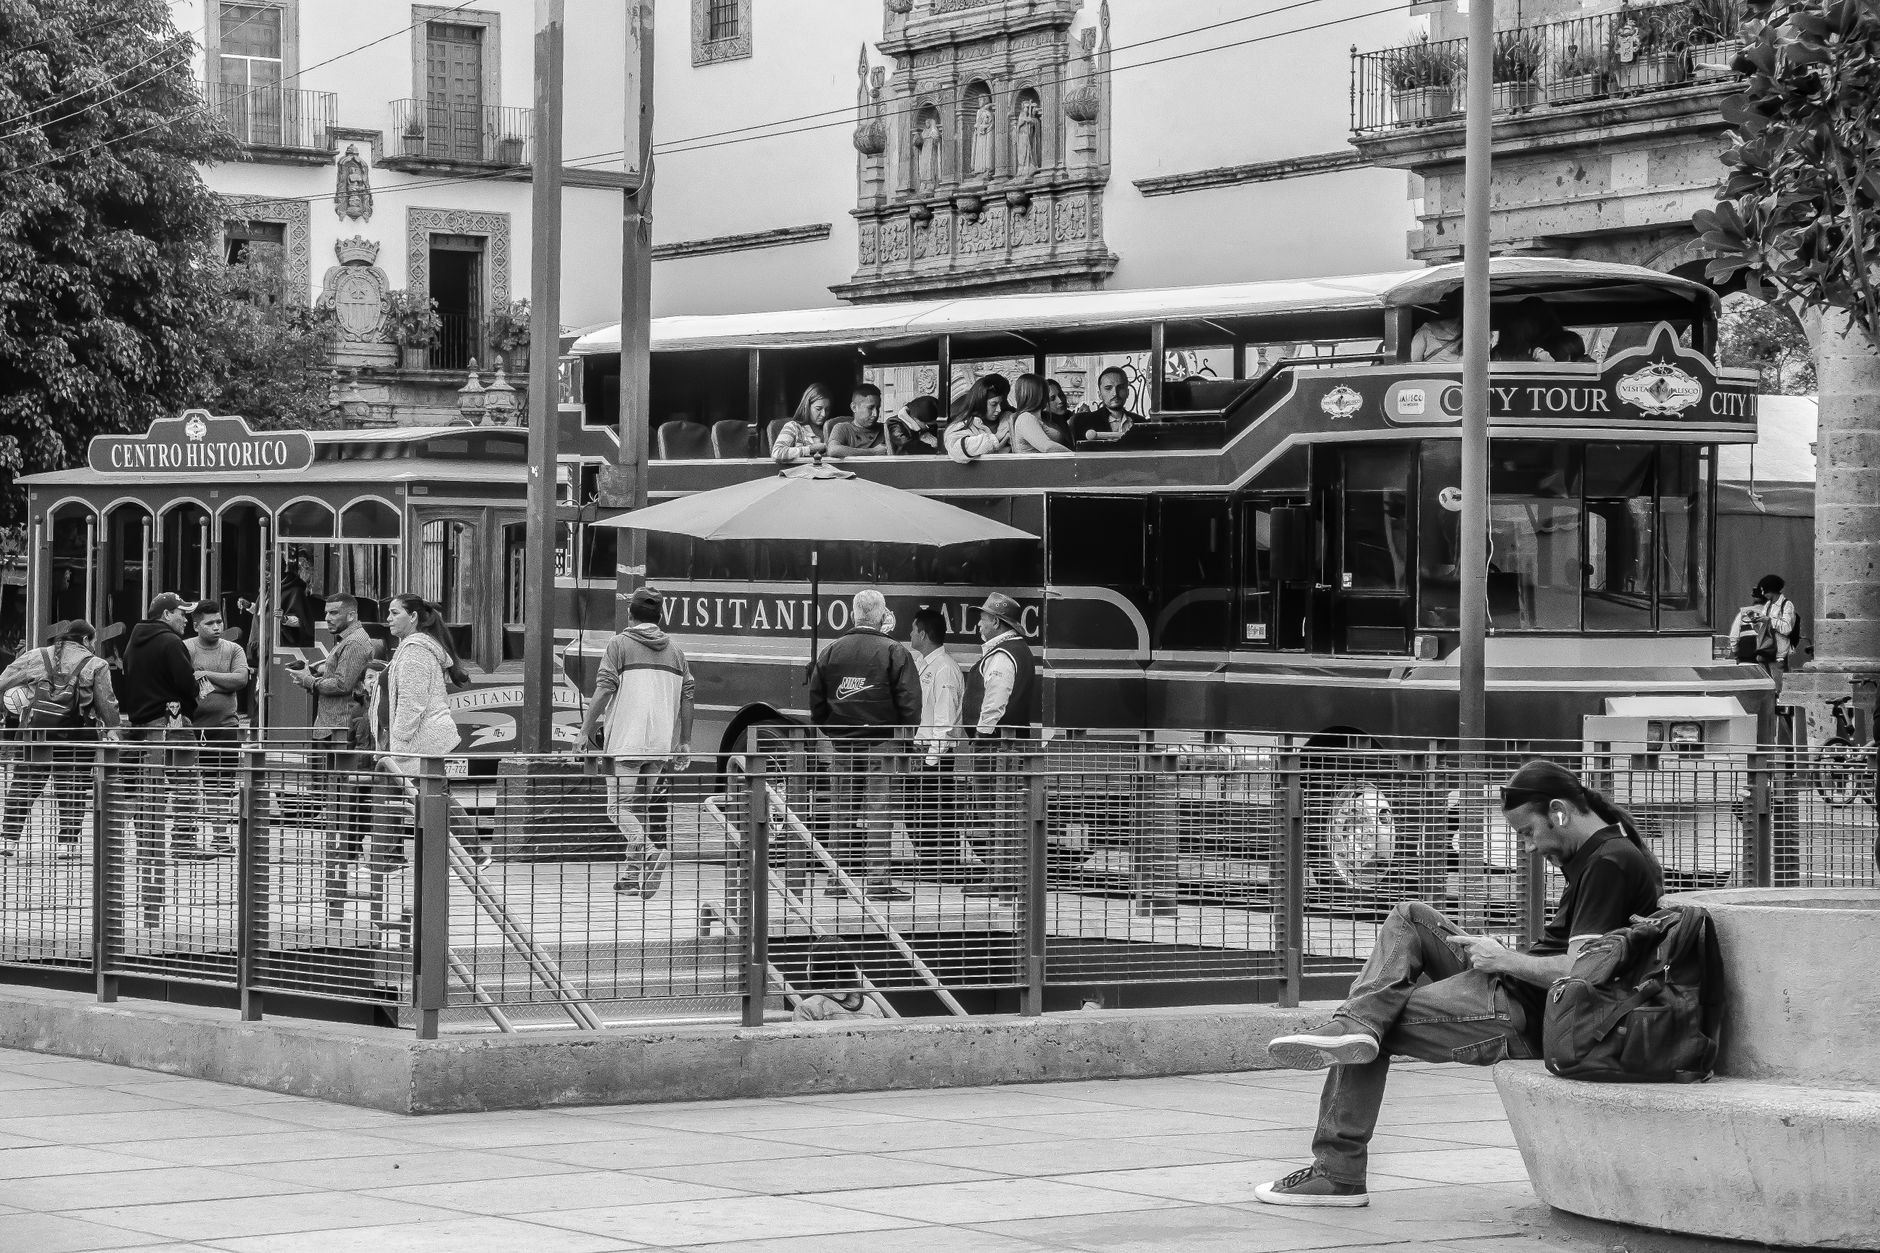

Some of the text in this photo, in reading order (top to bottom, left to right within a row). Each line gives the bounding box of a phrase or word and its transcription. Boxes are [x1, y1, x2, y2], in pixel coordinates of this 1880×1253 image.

[1444, 387, 1611, 412] CY TOUR
[1710, 391, 1747, 417] CITY
[111, 440, 287, 468] CENTRO HISTORICO
[662, 597, 849, 631] VISITANDO
[841, 676, 867, 690] NIKE
[450, 690, 524, 709] ISITAND
